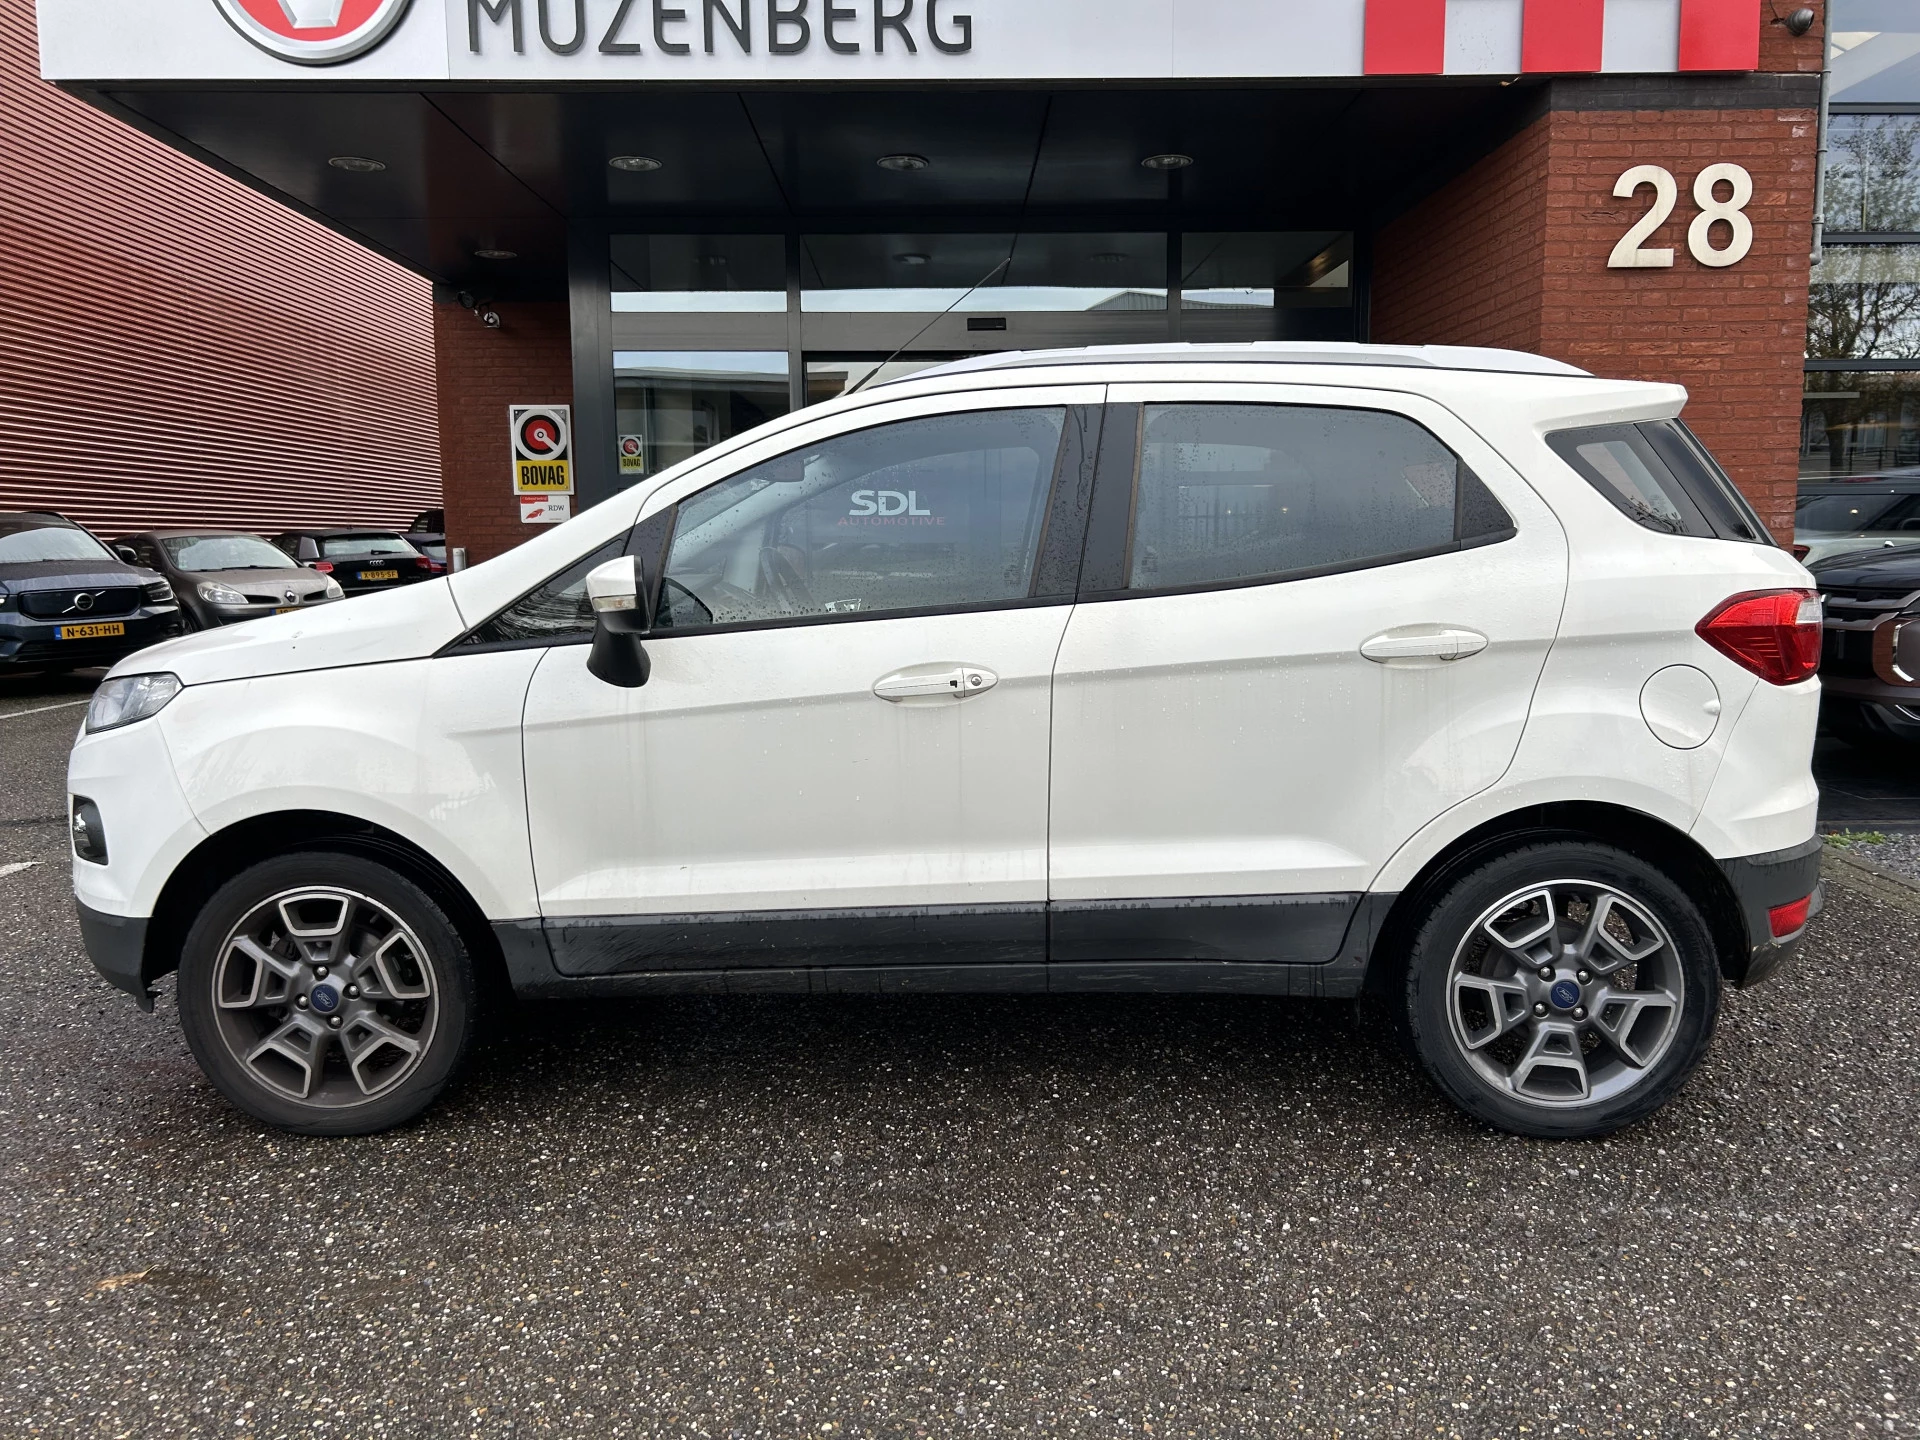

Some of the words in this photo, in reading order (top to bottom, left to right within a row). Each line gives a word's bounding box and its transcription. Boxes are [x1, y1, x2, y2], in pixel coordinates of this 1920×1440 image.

[467, 0, 972, 53] MUZENBERG
[1607, 163, 1753, 267] 28
[622, 458, 641, 467] BOVAG
[521, 465, 565, 485] BOVAG
[849, 490, 931, 516] SDL
[837, 516, 946, 526] AUTOMOTIVE
[66, 624, 120, 637] N-631-HH
